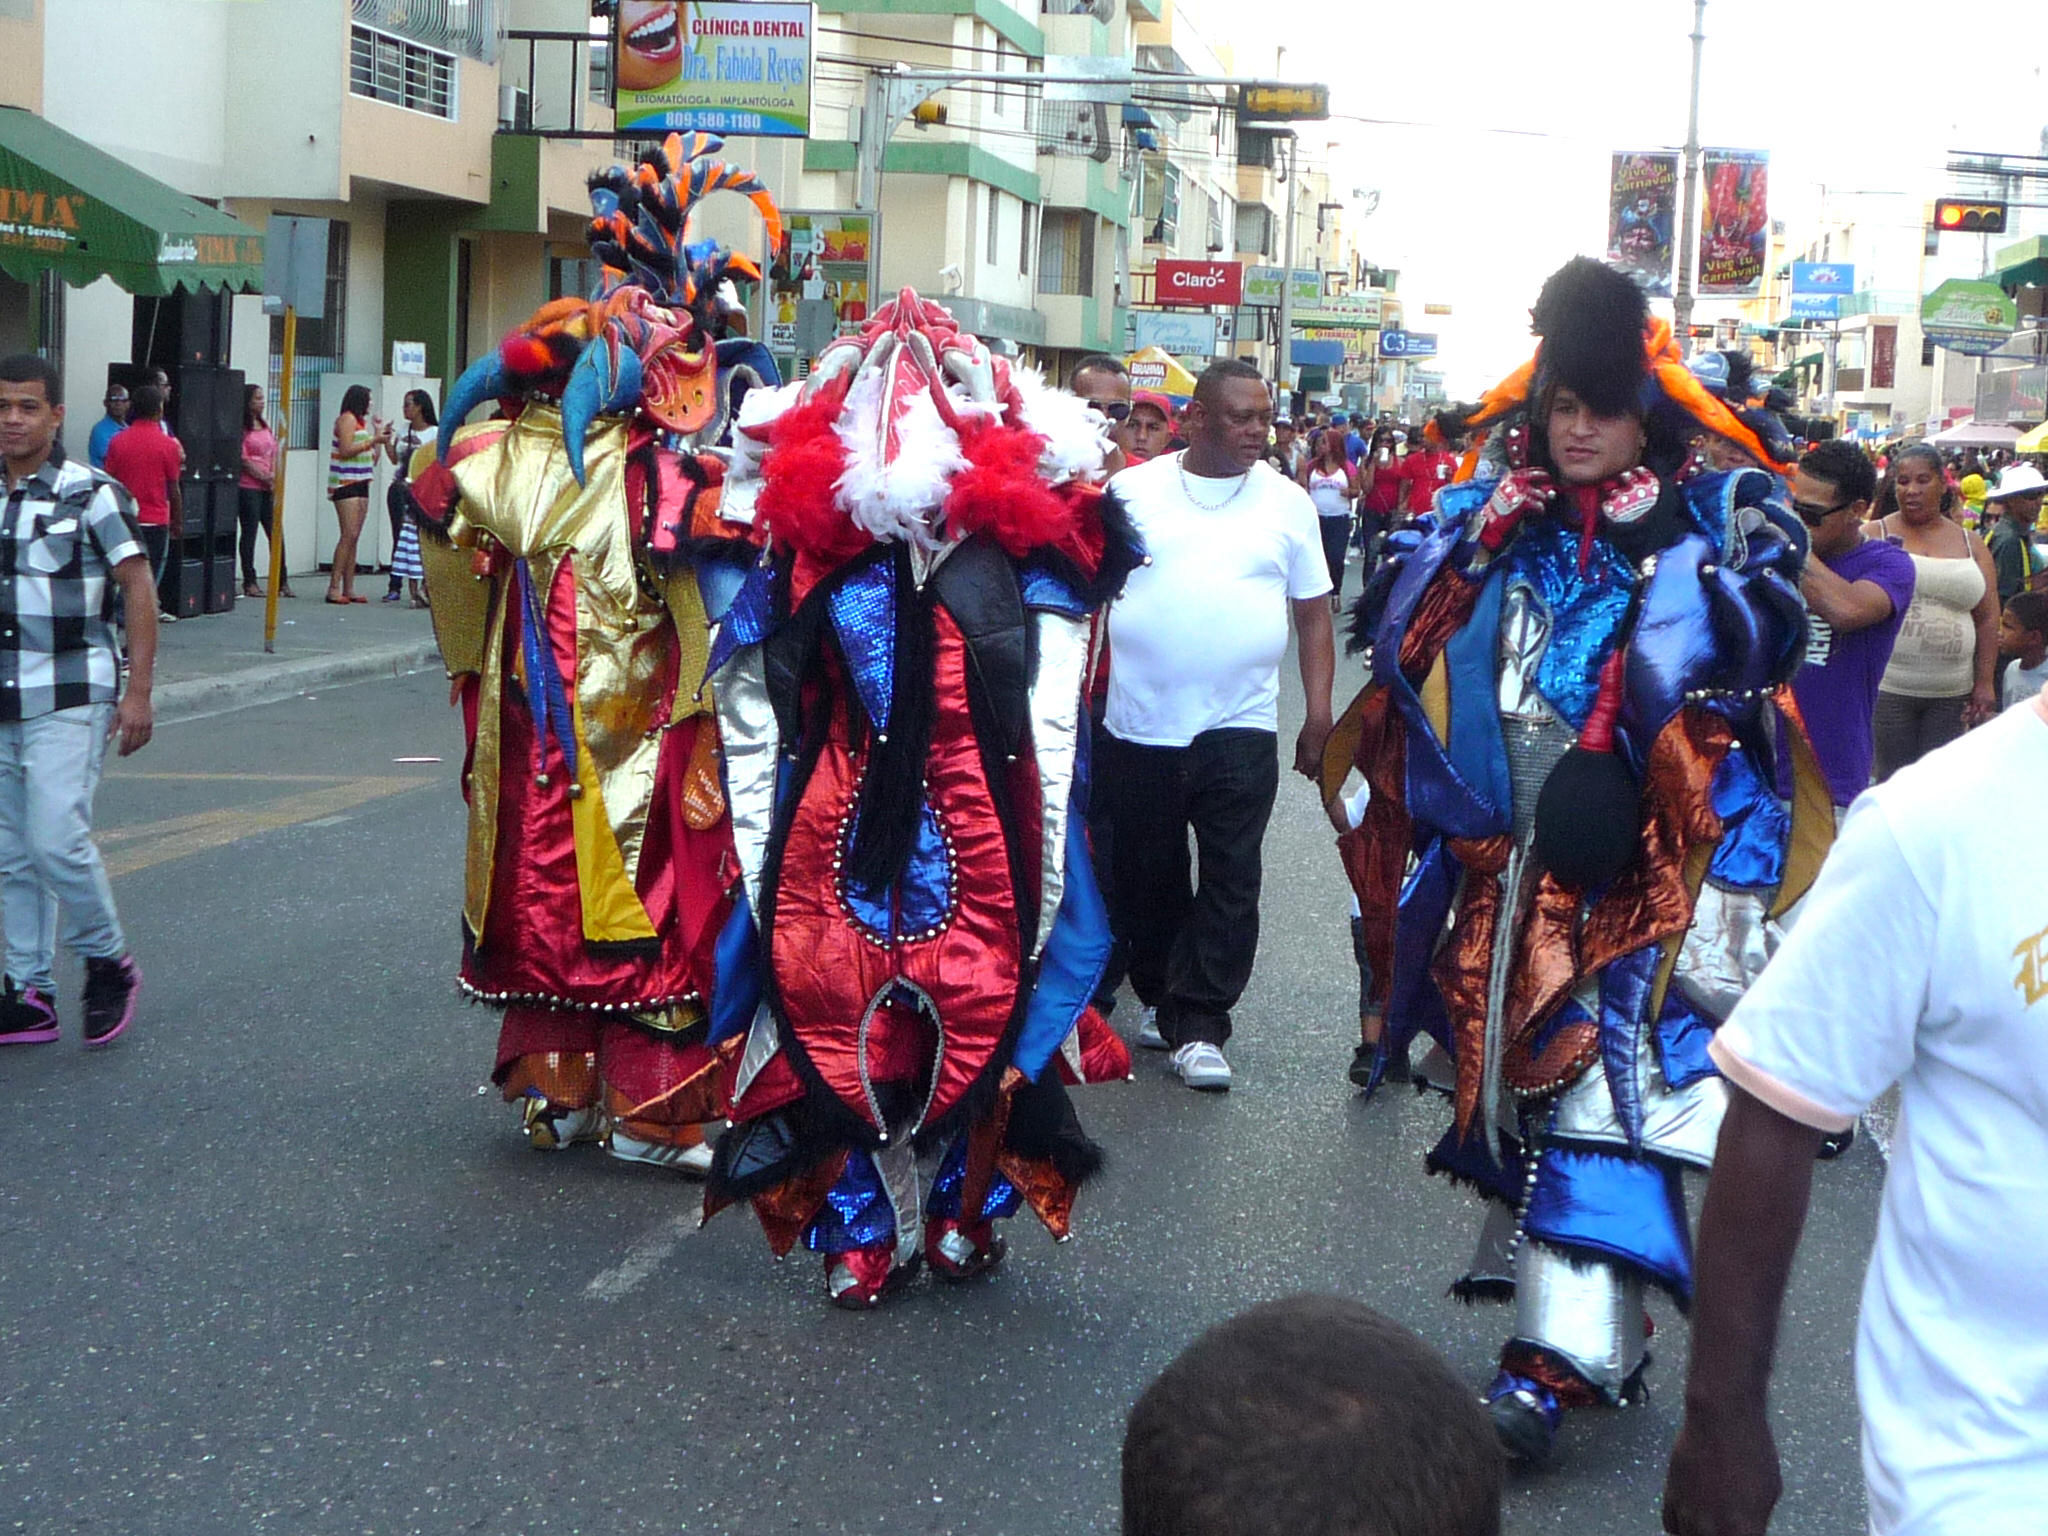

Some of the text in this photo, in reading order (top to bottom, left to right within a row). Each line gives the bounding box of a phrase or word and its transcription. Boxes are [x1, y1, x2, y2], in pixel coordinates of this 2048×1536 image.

[692, 17, 805, 38] CLÍNICA DENTAL
[684, 46, 803, 92] Dra. Fabiola Reyes
[635, 93, 795, 107] ESTOMATÓLOGA IMPLANTÓLOGA
[1618, 163, 1668, 178] Vive tu
[1705, 256, 1753, 271] Vive tu
[1173, 270, 1218, 288] Claro
[1701, 264, 1761, 283] Carnaval!
[1792, 309, 1835, 317] MAYRA
[1383, 332, 1406, 352] C3
[1131, 363, 1165, 376] BRAHMA
[1131, 377, 1163, 387] LIGHT
